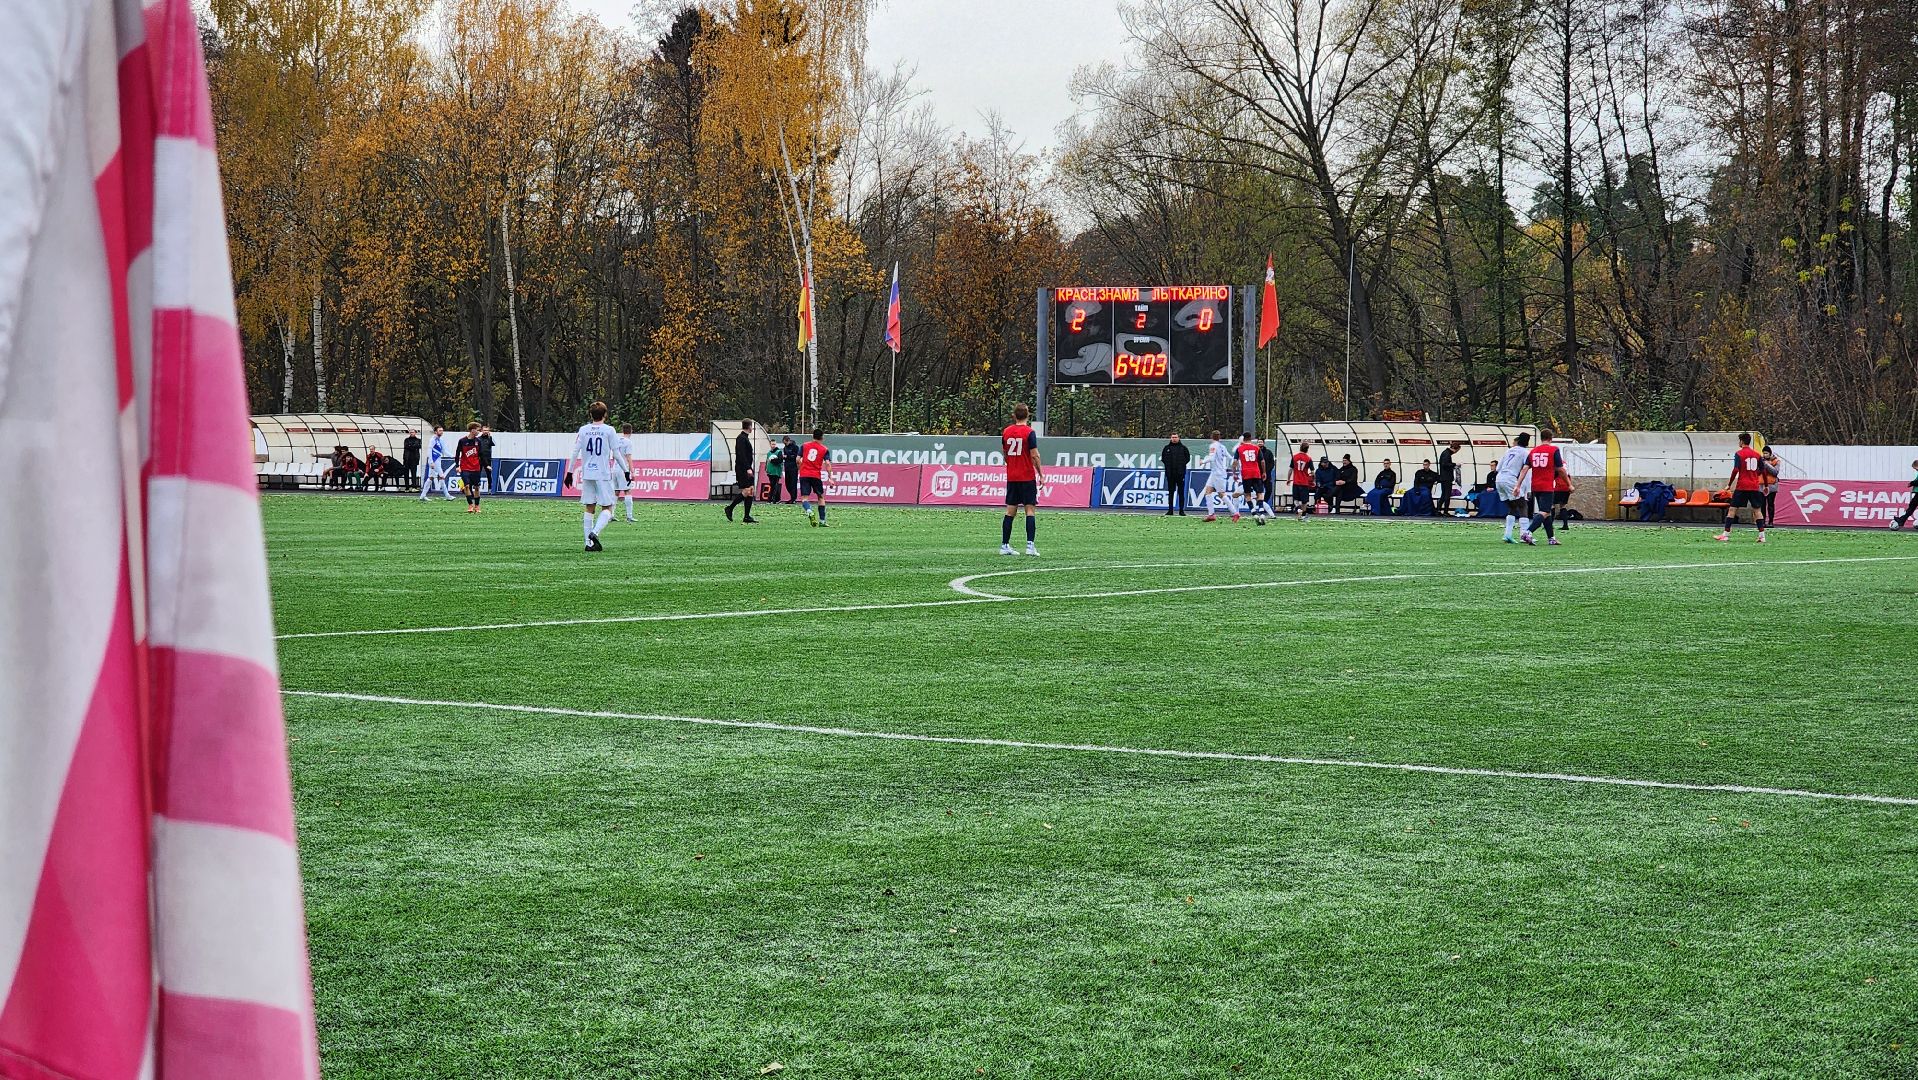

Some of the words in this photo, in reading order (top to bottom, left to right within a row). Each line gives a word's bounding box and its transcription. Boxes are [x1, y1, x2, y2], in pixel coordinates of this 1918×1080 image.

[1057, 288, 1140, 301] КРАСН.ЗНАМЯ
[1071, 309, 1086, 331] 2
[1137, 313, 1146, 329] 2
[1199, 308, 1213, 331] 0
[1116, 354, 1168, 376] 6403
[586, 437, 603, 456] 40
[1007, 438, 1023, 456] 21
[807, 448, 818, 462] 8
[1242, 450, 1256, 462] 15
[1508, 453, 1515, 466] 7
[1532, 453, 1549, 468] 55
[1296, 460, 1306, 471] 17
[1745, 457, 1758, 471] 10
[642, 468, 703, 479] ТРАНСЛЯЦИИ
[631, 481, 659, 493] amya
[663, 480, 679, 491] TV
[823, 486, 894, 498] ЕЛЕКОМ
[962, 487, 977, 496] на
[981, 485, 1007, 497] Zna
[1840, 490, 1914, 504] ЗНАМ
